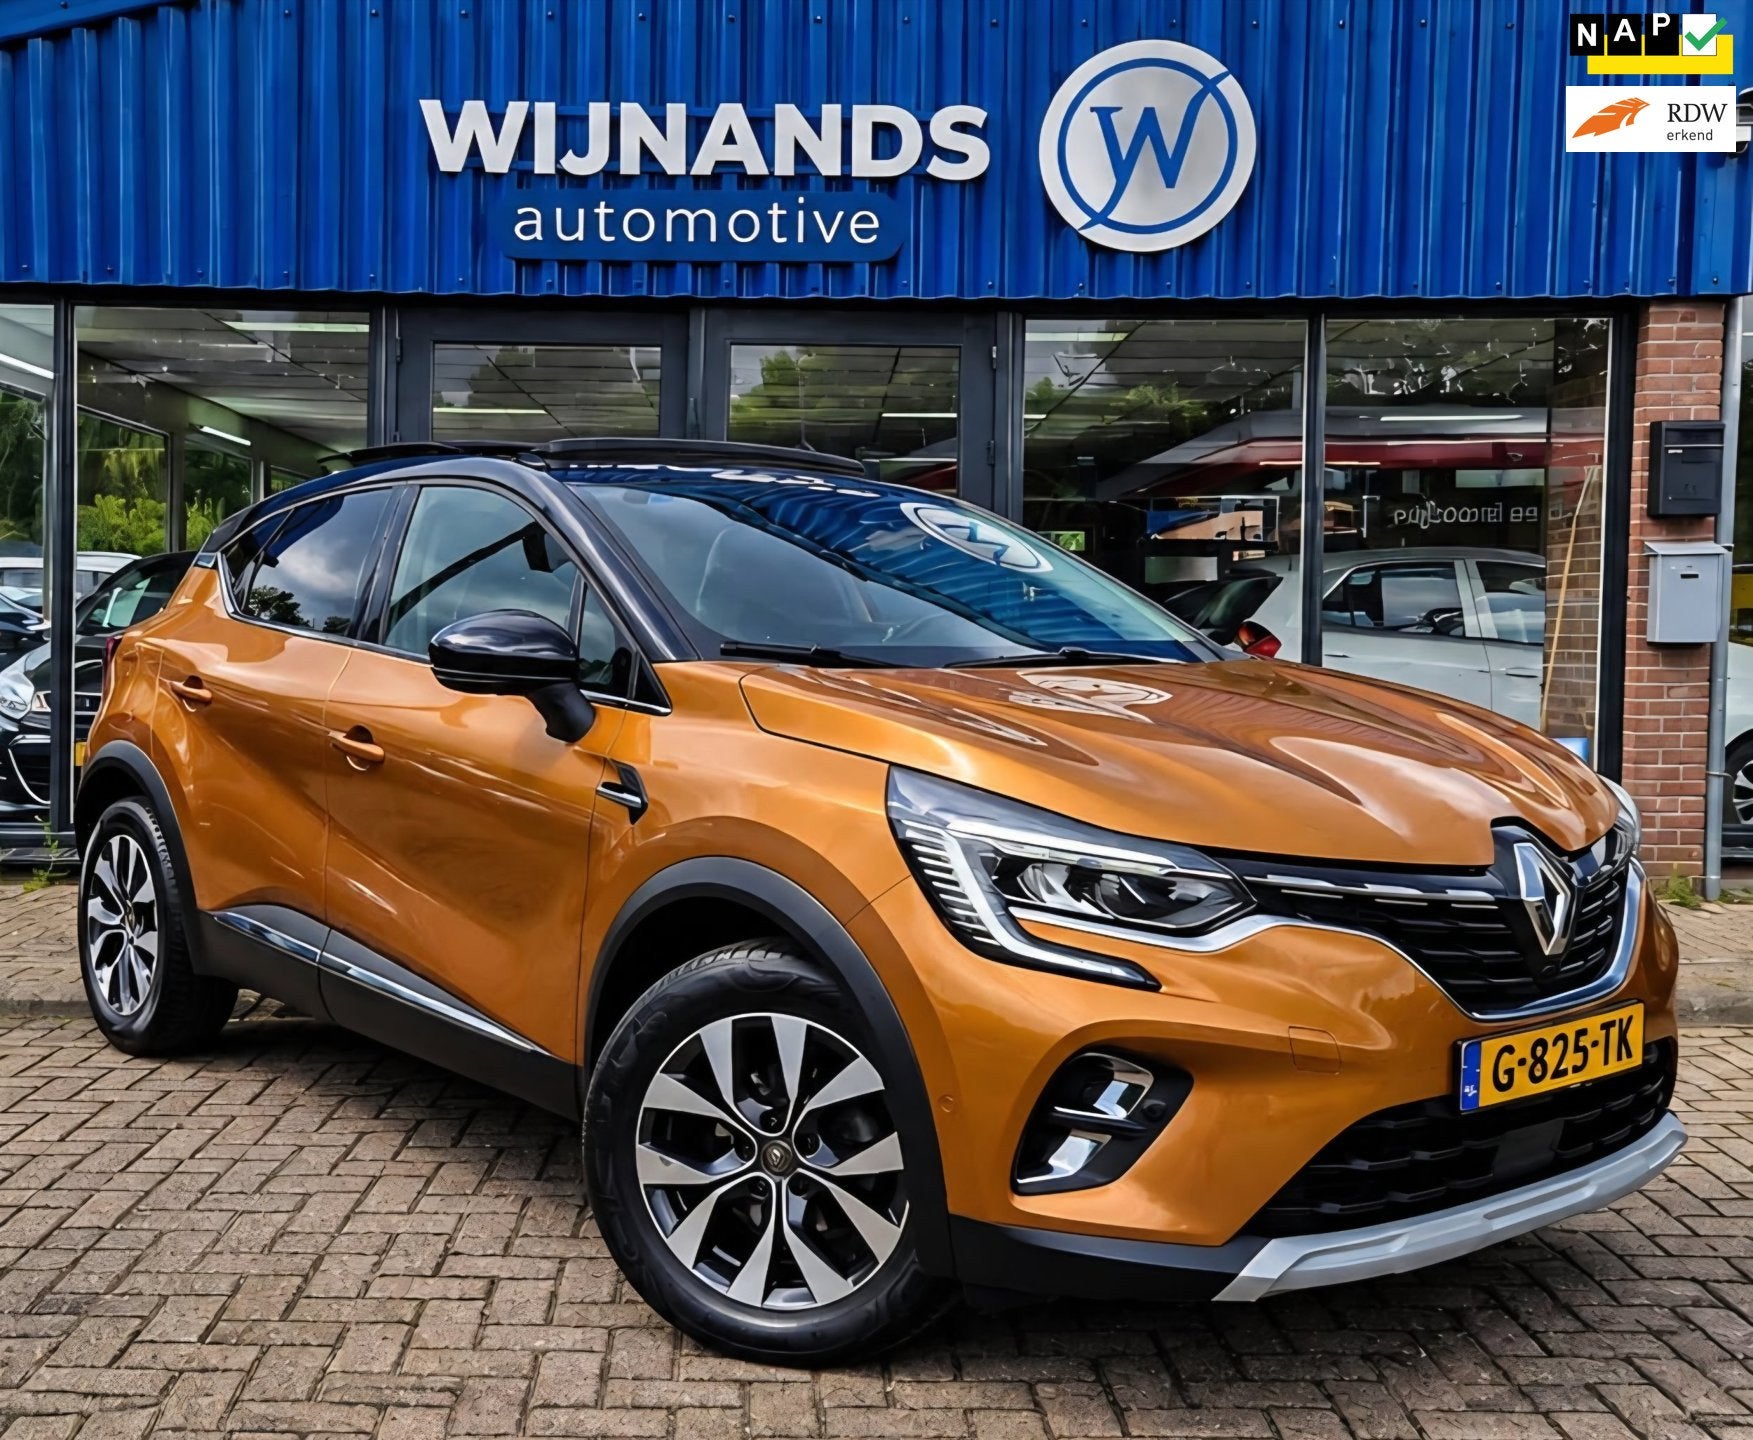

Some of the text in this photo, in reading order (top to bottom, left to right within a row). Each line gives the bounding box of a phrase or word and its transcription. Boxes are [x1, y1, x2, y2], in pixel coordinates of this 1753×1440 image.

[419, 99, 990, 181] WIJNANDS
[514, 196, 880, 243] automotive
[1492, 1014, 1633, 1092] G-825-TK
